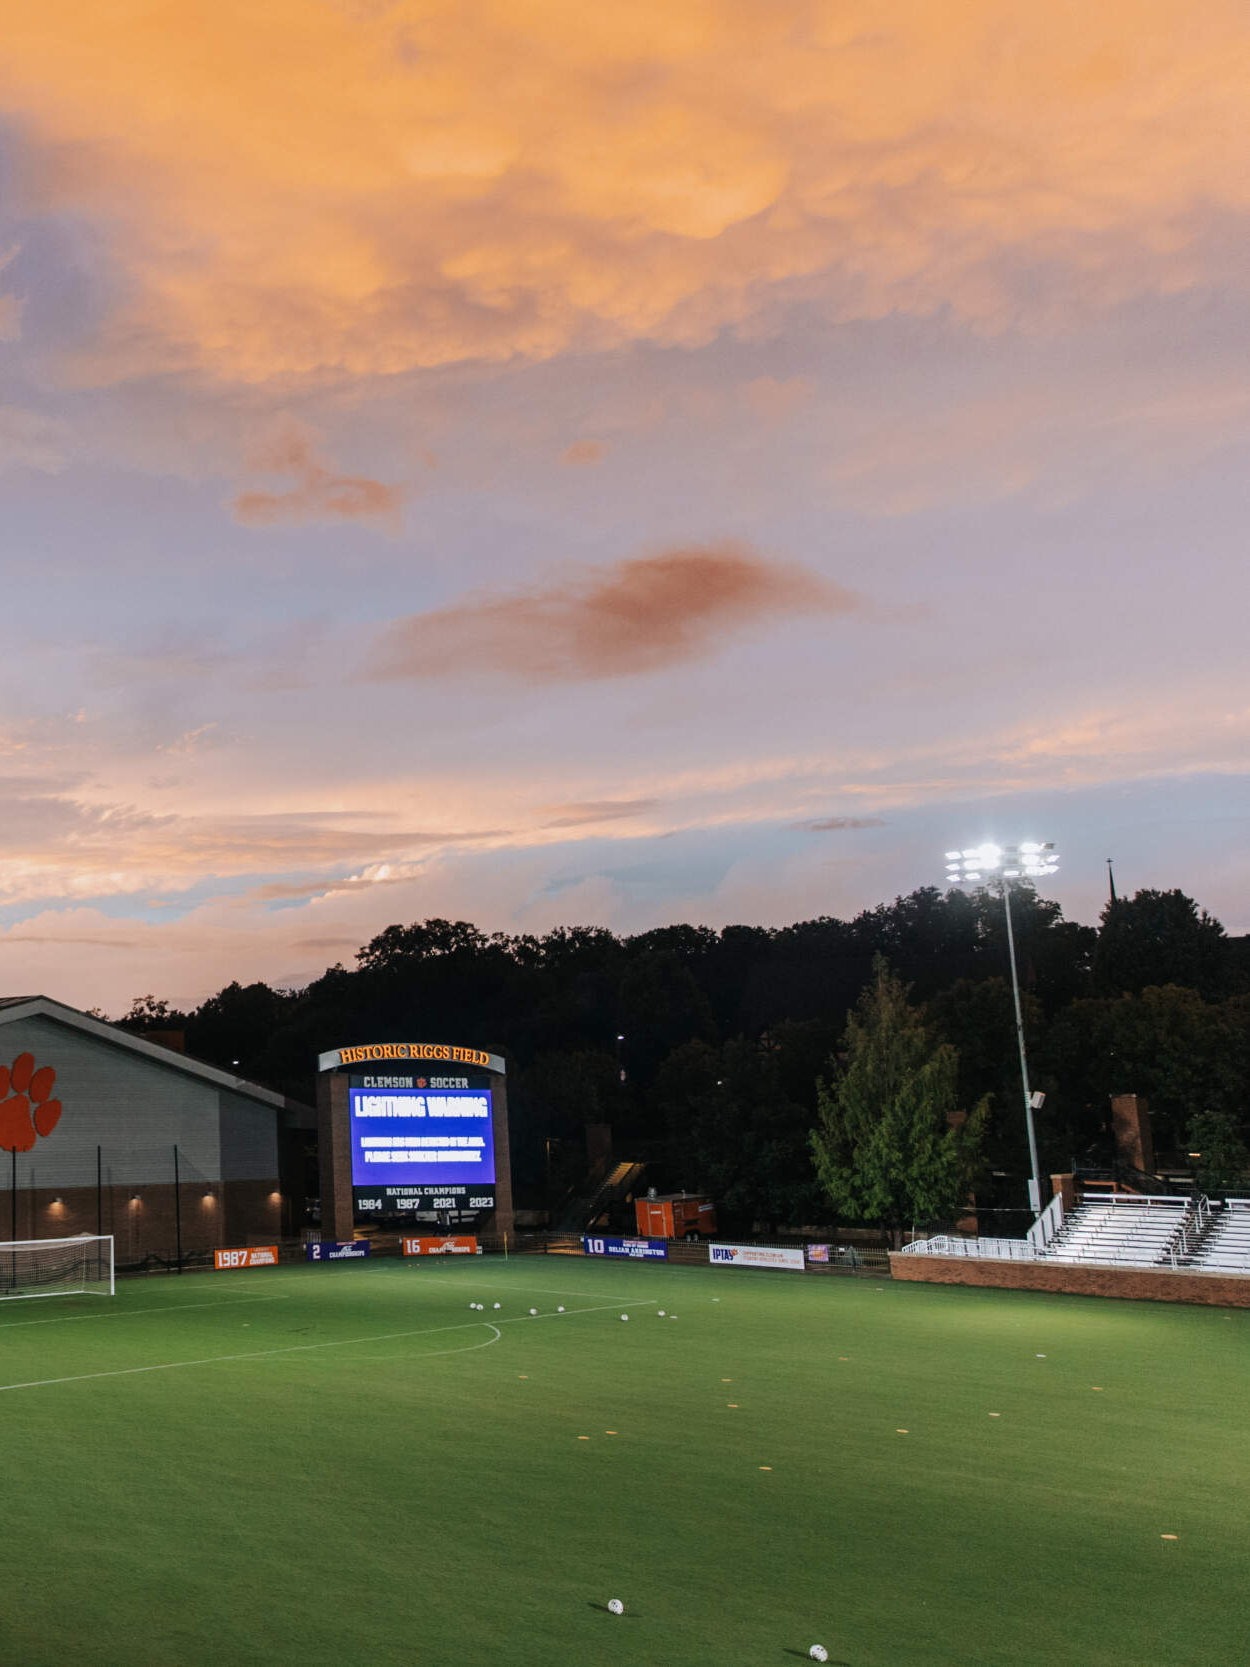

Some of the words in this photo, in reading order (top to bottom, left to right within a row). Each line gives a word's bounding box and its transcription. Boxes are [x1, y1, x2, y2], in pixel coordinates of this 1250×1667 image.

[340, 1044, 407, 1064] HISTORIC
[409, 1044, 450, 1059] RIGGS
[452, 1046, 489, 1065] FIELD
[364, 1076, 413, 1088] CLEMSON
[430, 1077, 469, 1088] SOCCER
[355, 1096, 426, 1117] LIGHTNING
[426, 1097, 488, 1117] WARNING
[386, 1187, 422, 1196] NATIONAL
[424, 1187, 466, 1195] CHAMPIONS
[358, 1199, 382, 1210] 1984
[397, 1199, 420, 1209] 1987
[433, 1198, 456, 1208] 2021
[470, 1197, 494, 1208] 2023
[313, 1244, 321, 1259] 2
[406, 1240, 420, 1253] 16
[587, 1239, 604, 1253] 10
[218, 1250, 248, 1267] 1987
